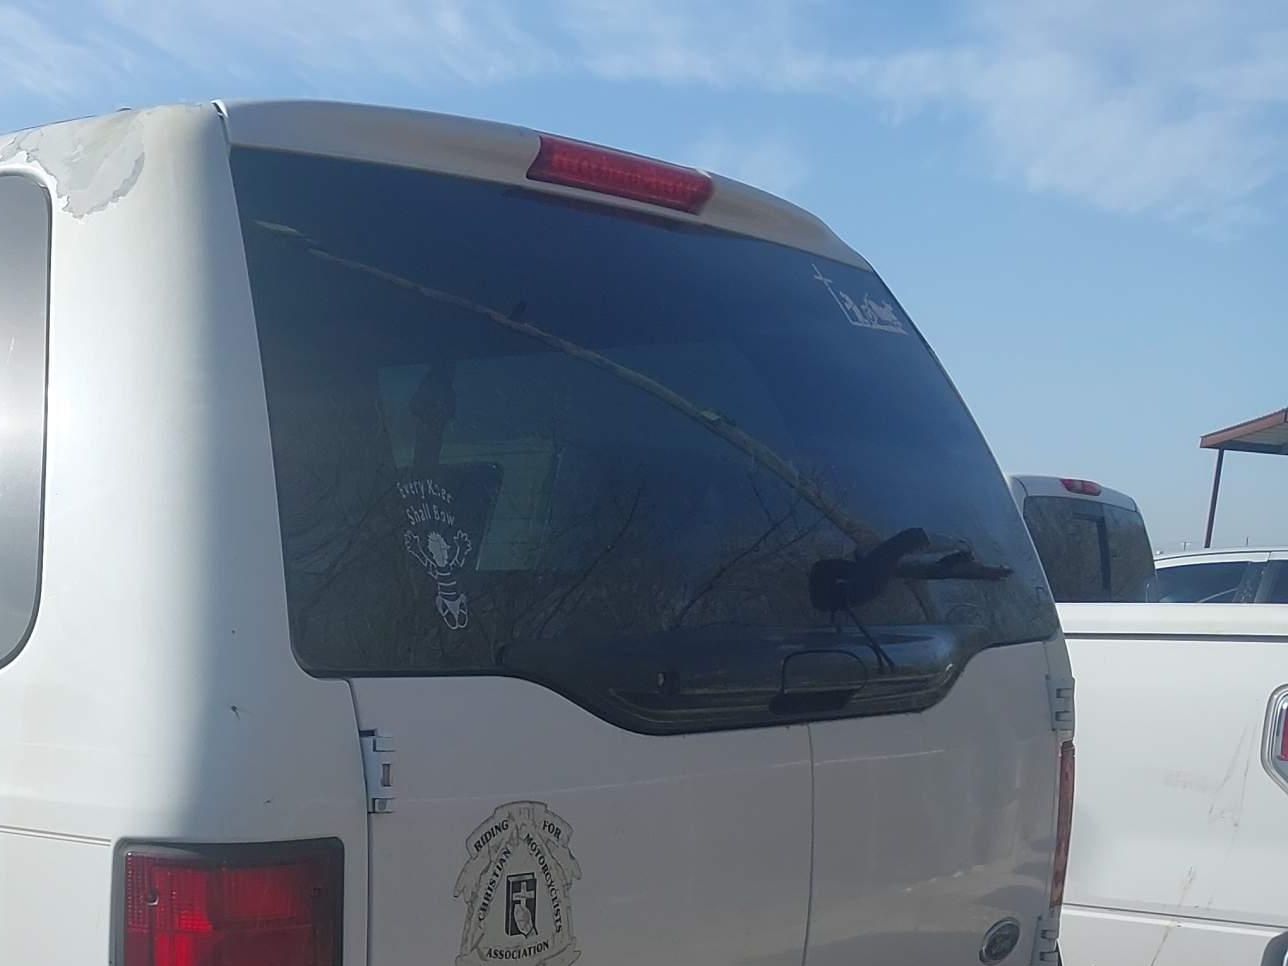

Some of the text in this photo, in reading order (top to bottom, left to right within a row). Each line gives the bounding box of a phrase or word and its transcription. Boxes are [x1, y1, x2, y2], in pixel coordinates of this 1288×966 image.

[396, 480, 425, 499] Every
[406, 503, 455, 526] Shall Bow
[474, 820, 562, 853] RIDING FOR
[478, 833, 563, 933] CHRISTIAN MOTORCYCLISTS
[486, 941, 549, 960] ASSOCIATION
